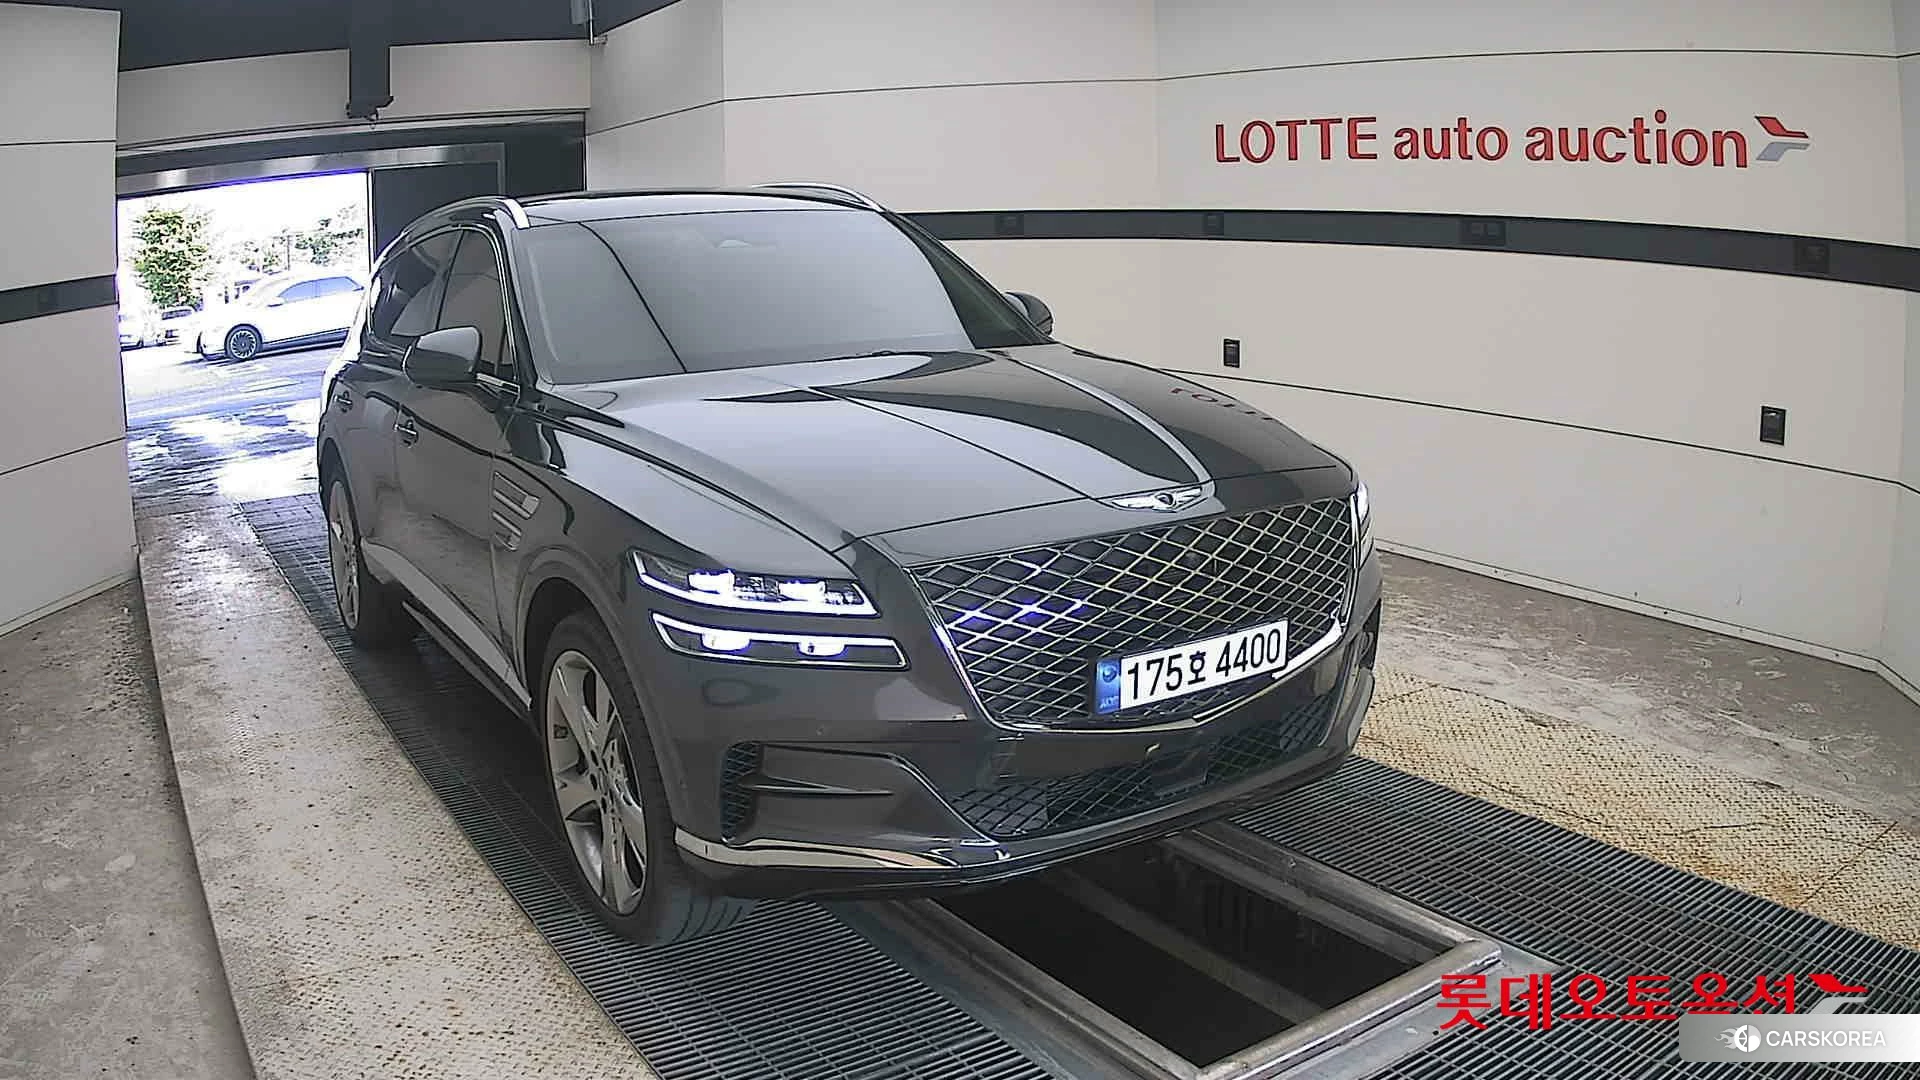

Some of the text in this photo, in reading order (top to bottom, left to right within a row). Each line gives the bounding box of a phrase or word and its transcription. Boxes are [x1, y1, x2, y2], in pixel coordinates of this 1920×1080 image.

[1215, 109, 1749, 169] LOTTE auto auction
[1127, 628, 1281, 700] 175호 4400
